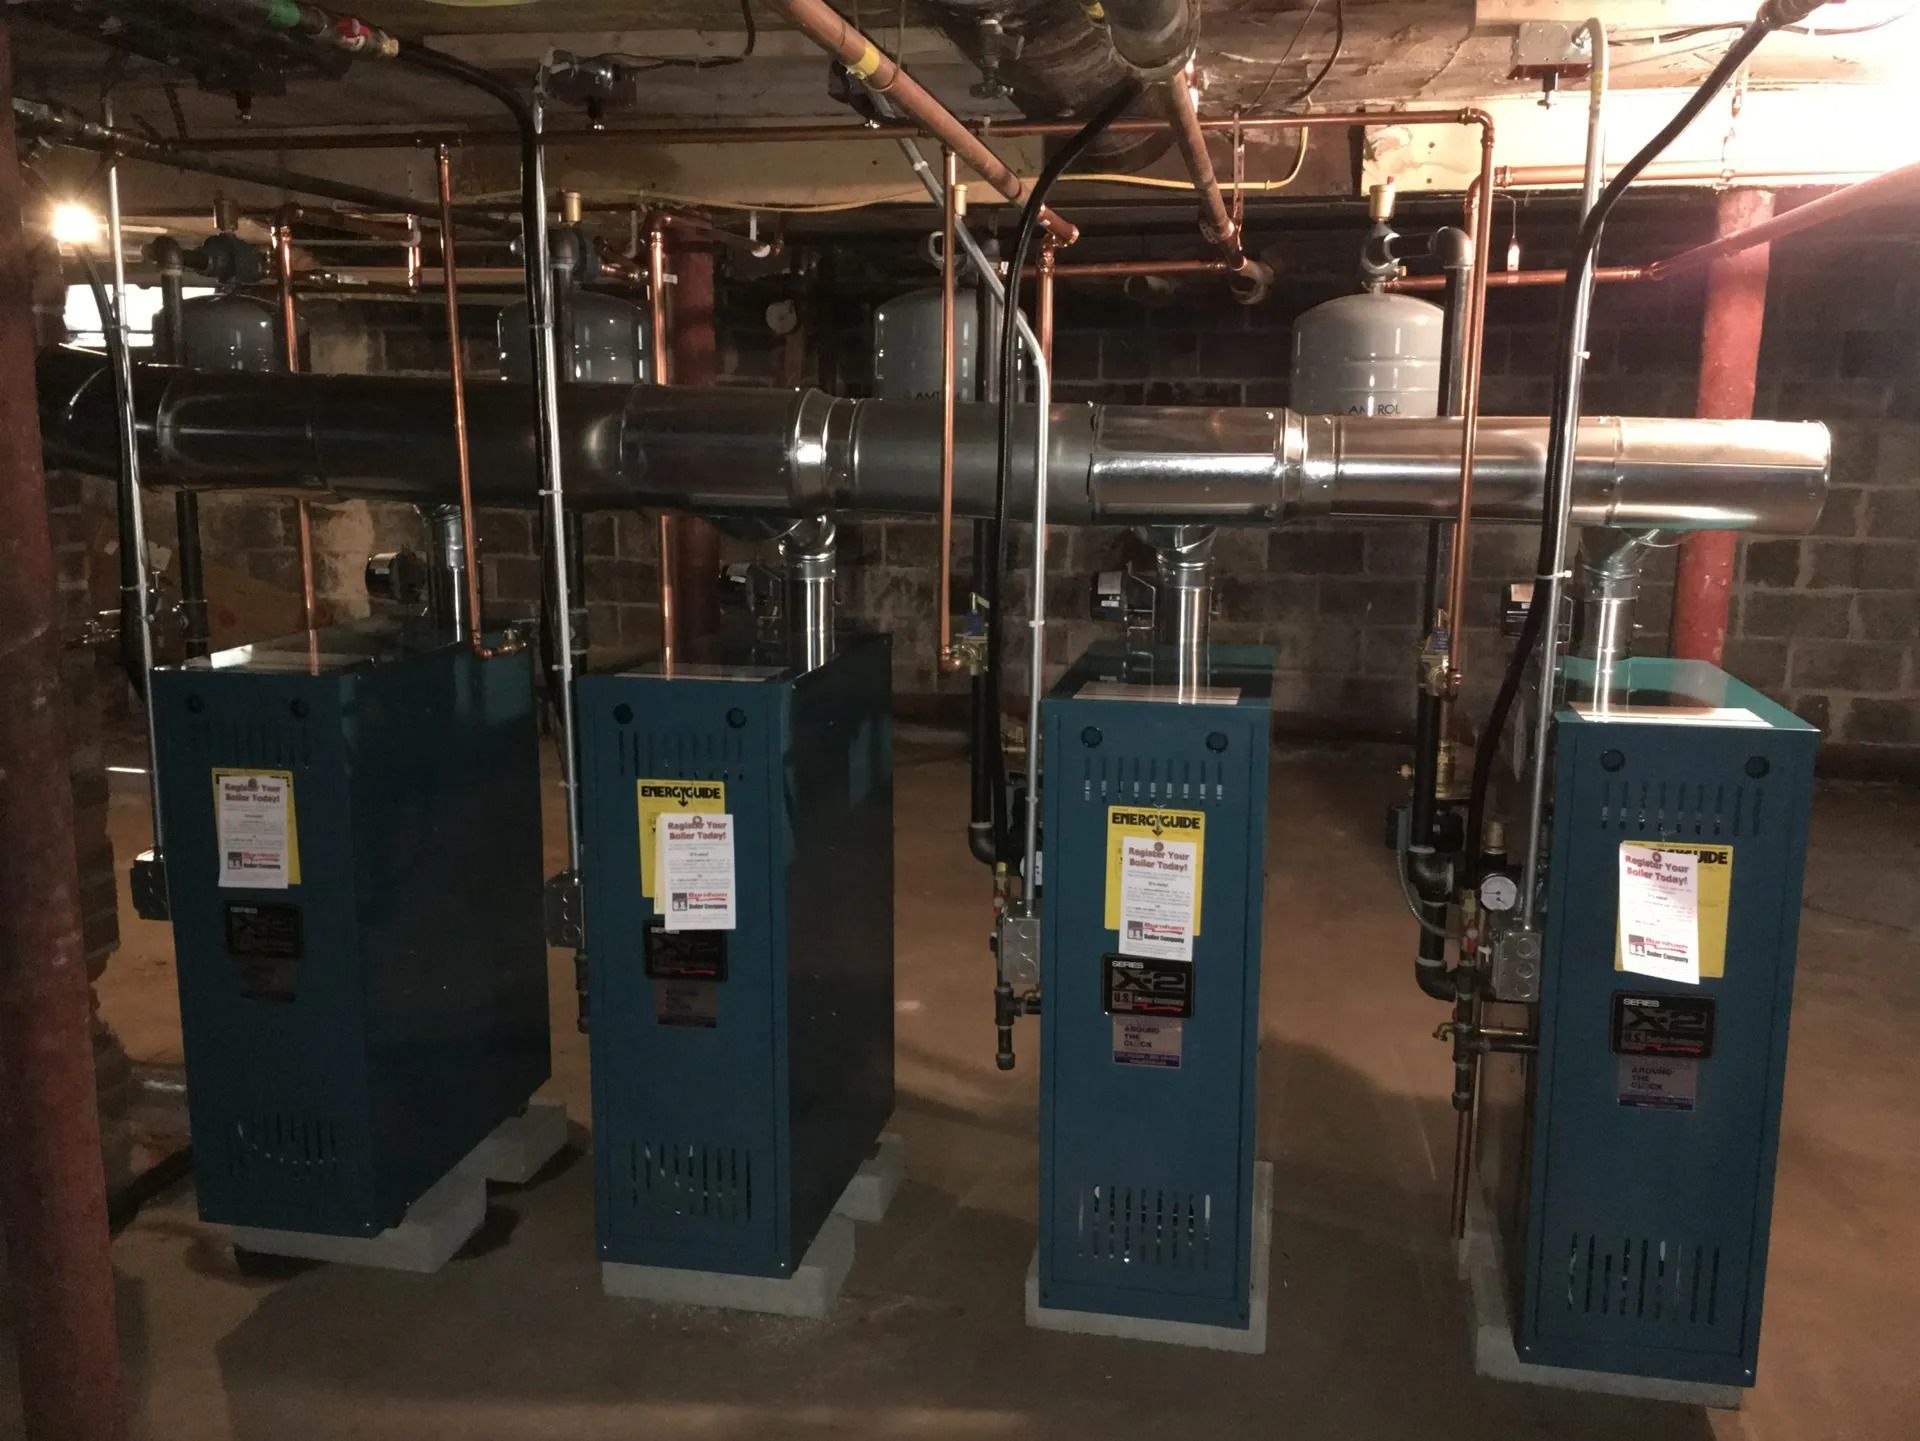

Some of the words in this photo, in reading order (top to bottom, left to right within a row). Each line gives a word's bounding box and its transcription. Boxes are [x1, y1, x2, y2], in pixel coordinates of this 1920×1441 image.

[1349, 404, 1402, 415] AMROL
[641, 785, 721, 800] ENERGYGUIDE
[706, 821, 728, 829] Your
[1112, 812, 1201, 829] ENERGYGUIDE
[669, 832, 695, 840] Boiler
[697, 832, 726, 841] Today!
[1129, 847, 1166, 859] Register
[1168, 851, 1190, 860] Your
[1129, 858, 1156, 868] Boiler
[1158, 861, 1187, 872] Today!
[1625, 855, 1664, 870] Register
[1665, 862, 1690, 873] Your
[1627, 866, 1654, 879] Boiler
[1655, 872, 1688, 886] Today!
[1124, 1041, 1152, 1049] CLCK
[1631, 1081, 1662, 1090] CLCK
